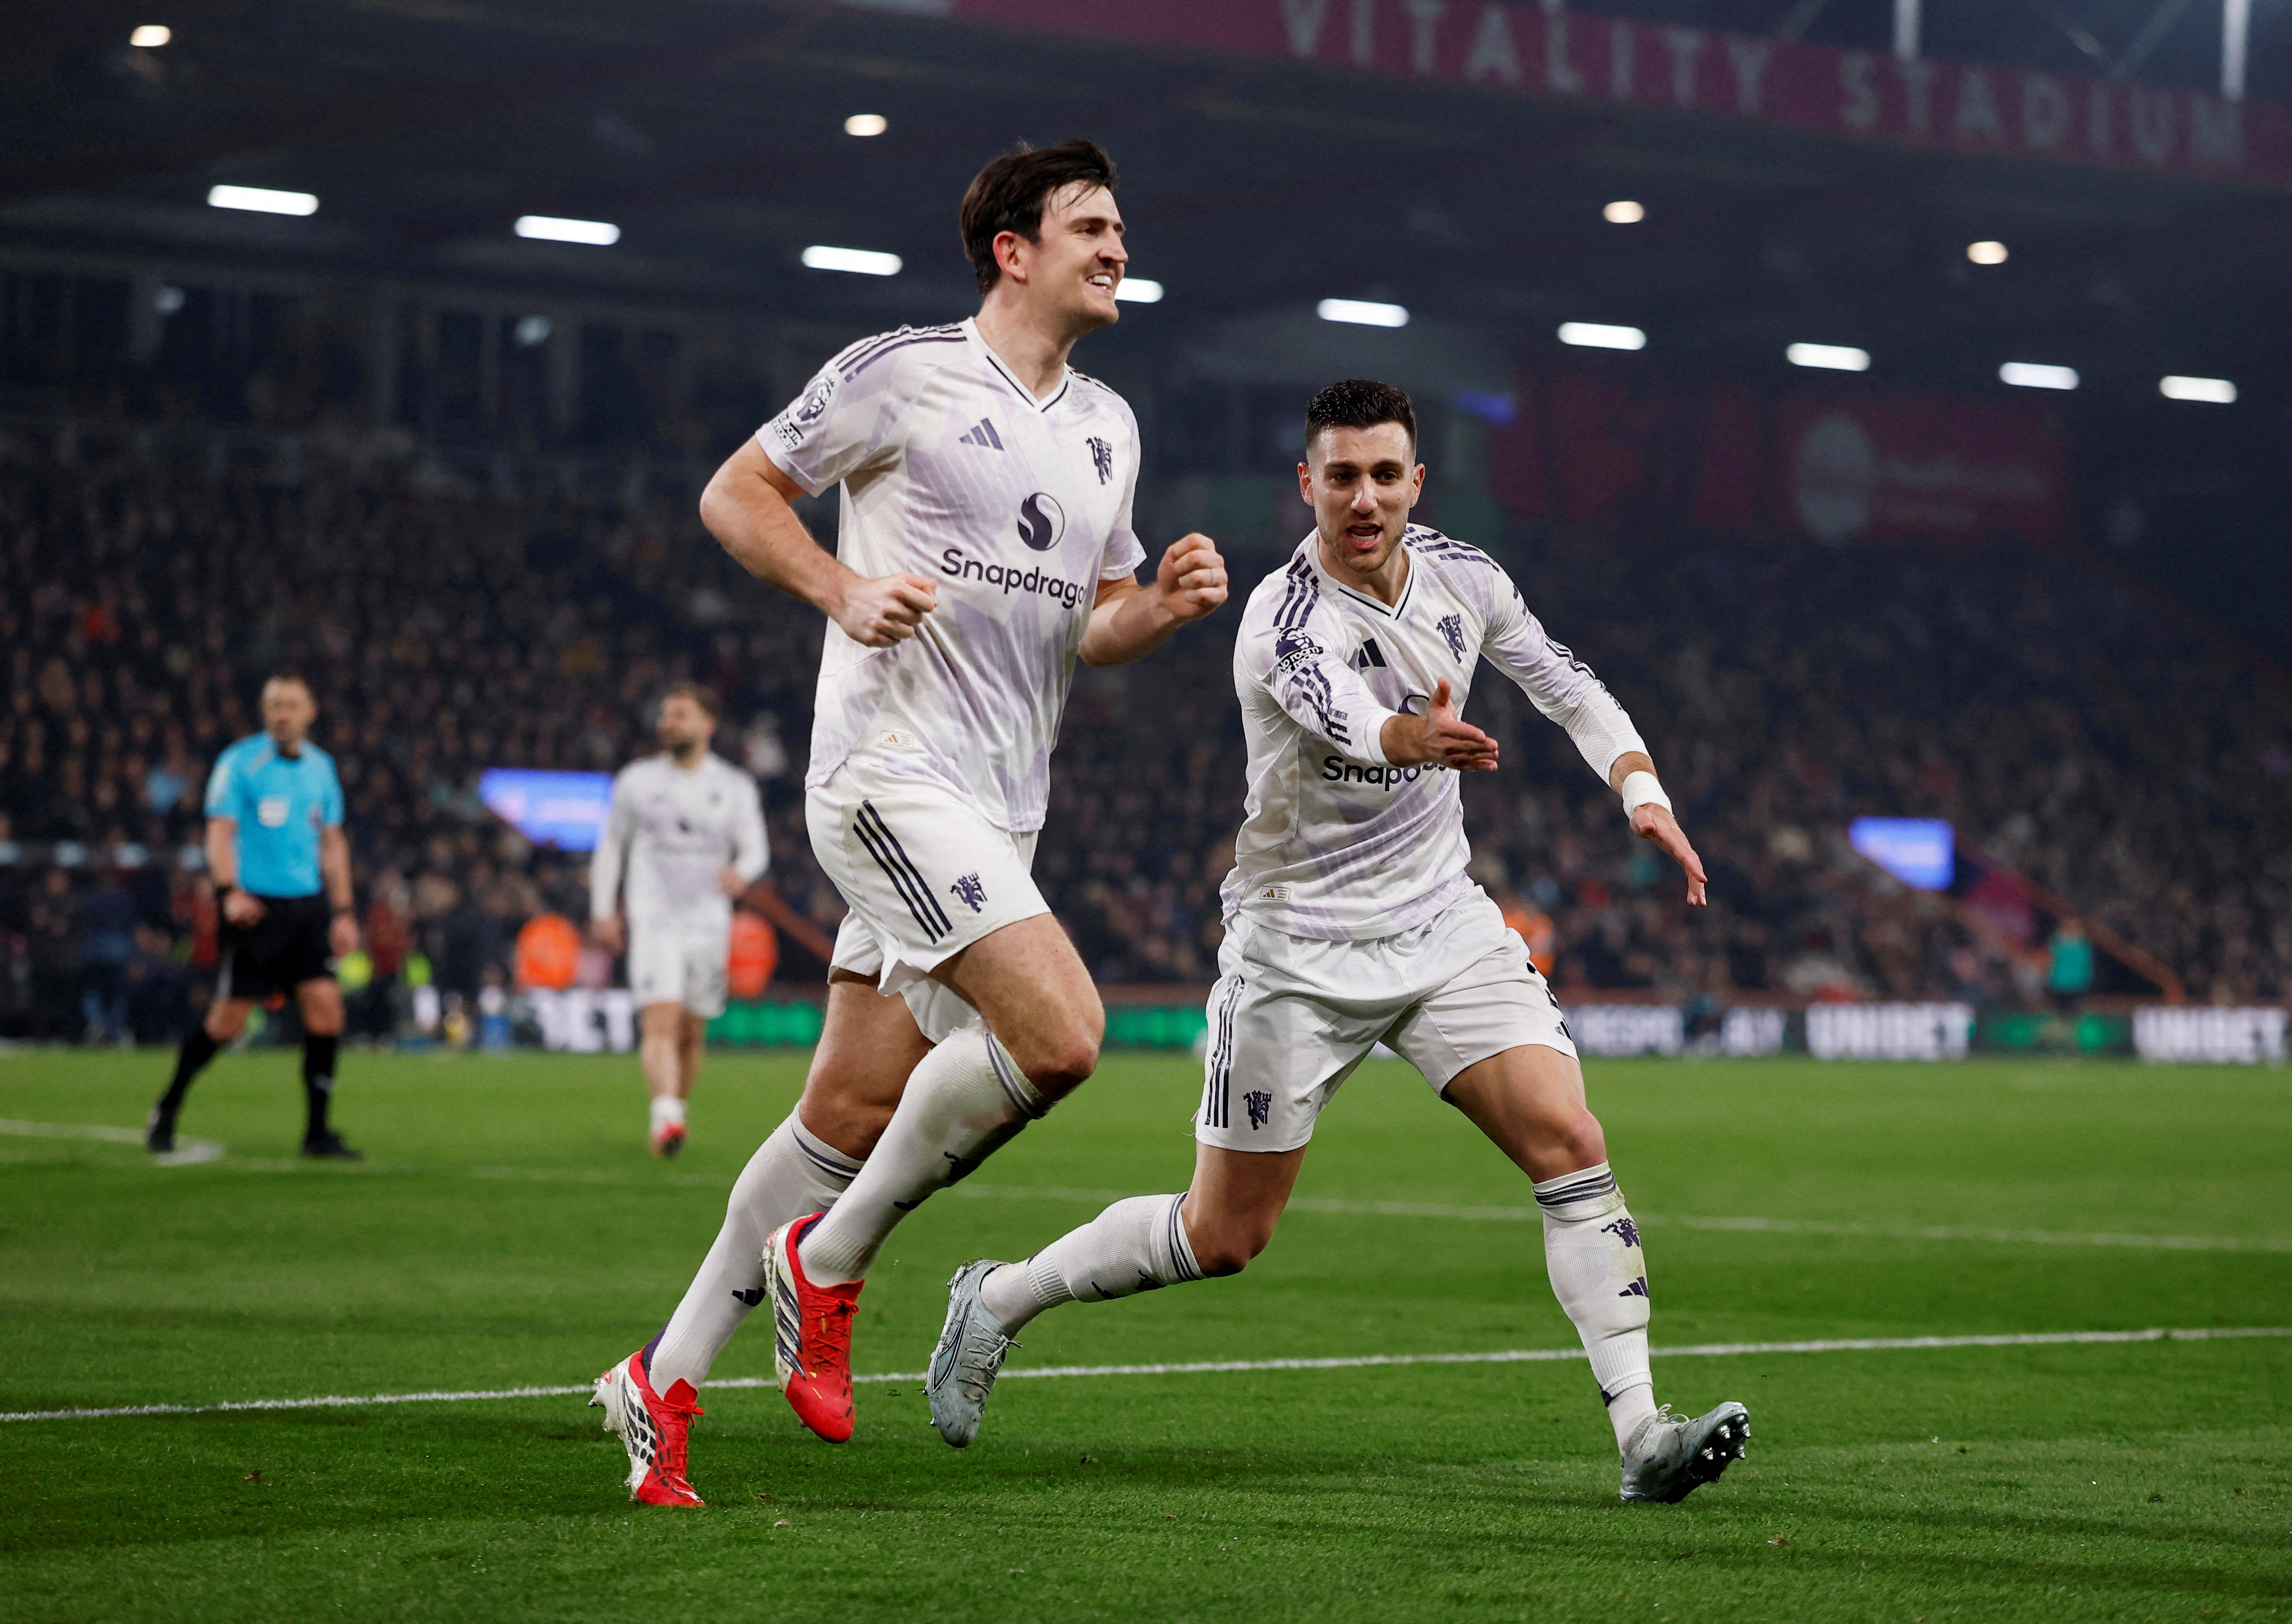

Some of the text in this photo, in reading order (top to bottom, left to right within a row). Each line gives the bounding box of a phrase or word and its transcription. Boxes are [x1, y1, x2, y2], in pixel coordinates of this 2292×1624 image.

[1279, 0, 2246, 167] VITALITY STADIUM
[940, 549, 1087, 610] Snapdrago
[1277, 647, 1319, 675] No room
[1806, 1001, 1972, 1059] UNIBET
[2133, 1005, 2287, 1064] UNIBET
